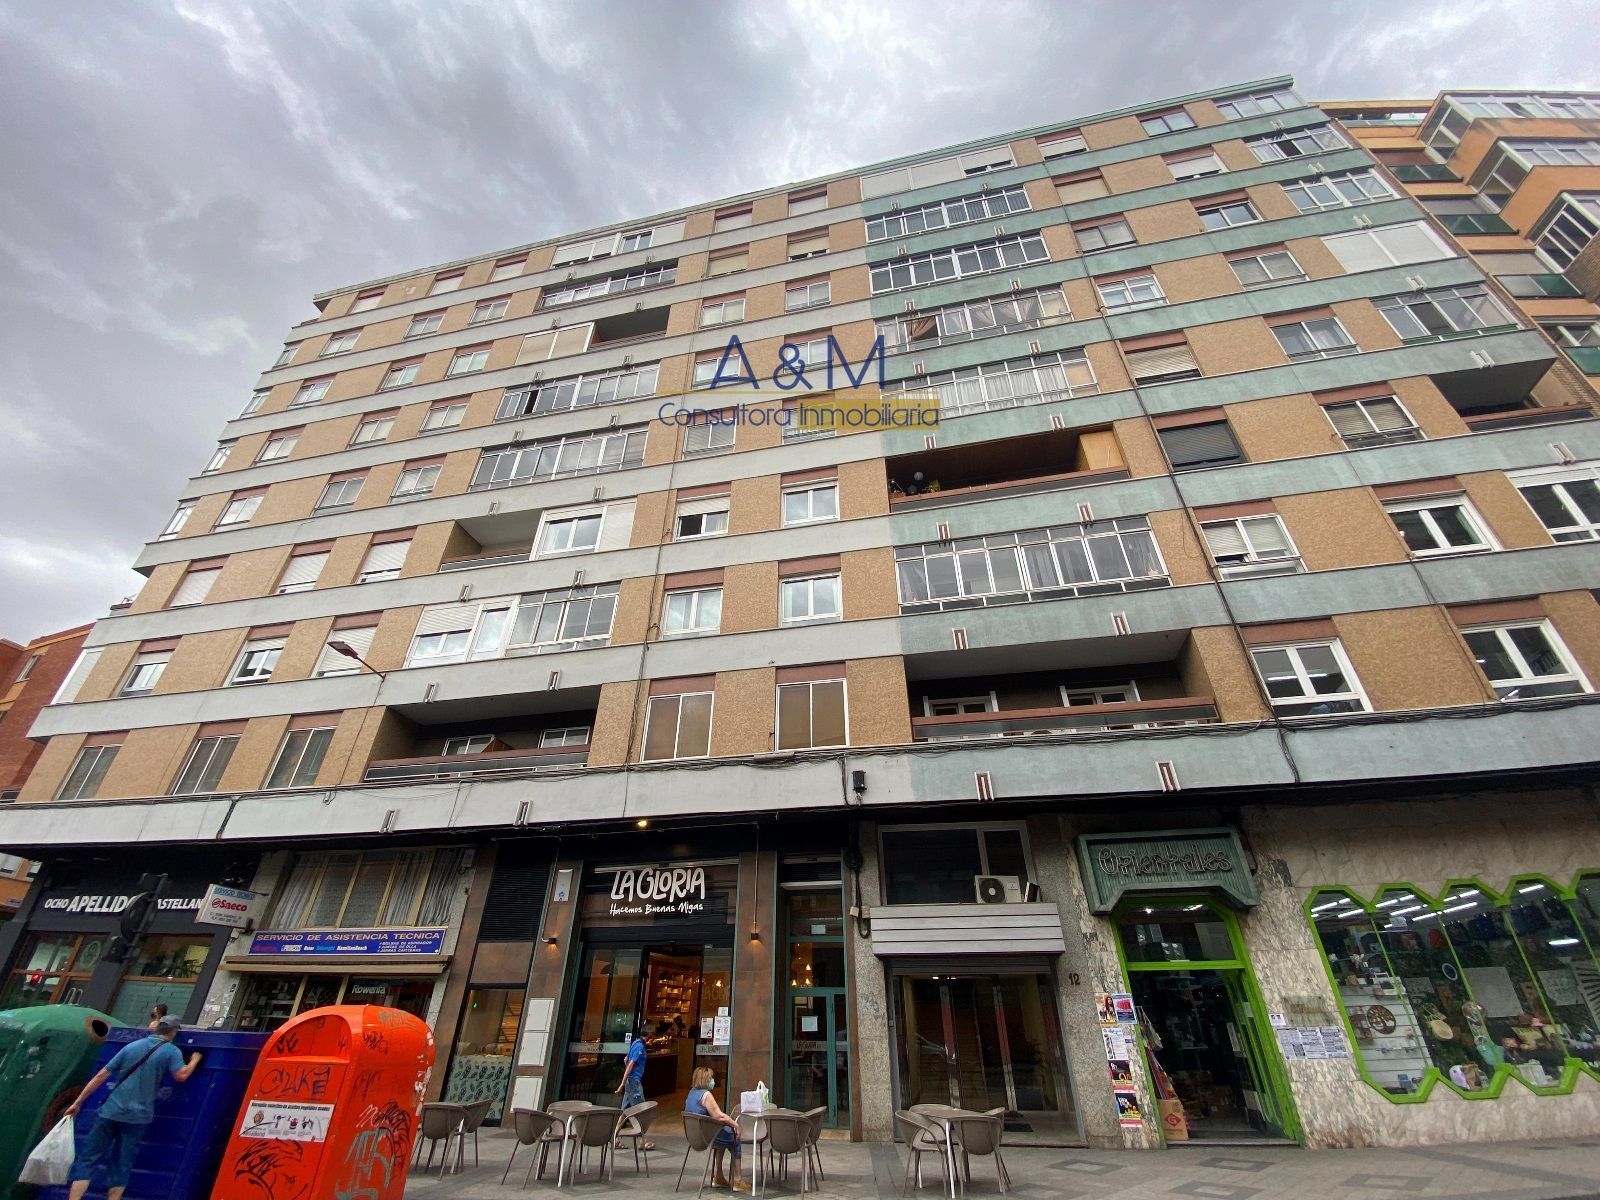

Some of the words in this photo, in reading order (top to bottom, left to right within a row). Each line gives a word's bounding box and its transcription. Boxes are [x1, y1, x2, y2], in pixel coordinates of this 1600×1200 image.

[1098, 844, 1232, 875] Orientales
[610, 870, 635, 902] LA
[636, 868, 705, 902] GLORIA
[44, 898, 69, 909] OCHO
[220, 900, 248, 912] Saeco
[610, 903, 642, 916] Hacemos
[644, 904, 675, 914] Buenas
[678, 902, 704, 914] Migas
[1068, 972, 1080, 985] 12
[352, 984, 386, 994] Rowenta
